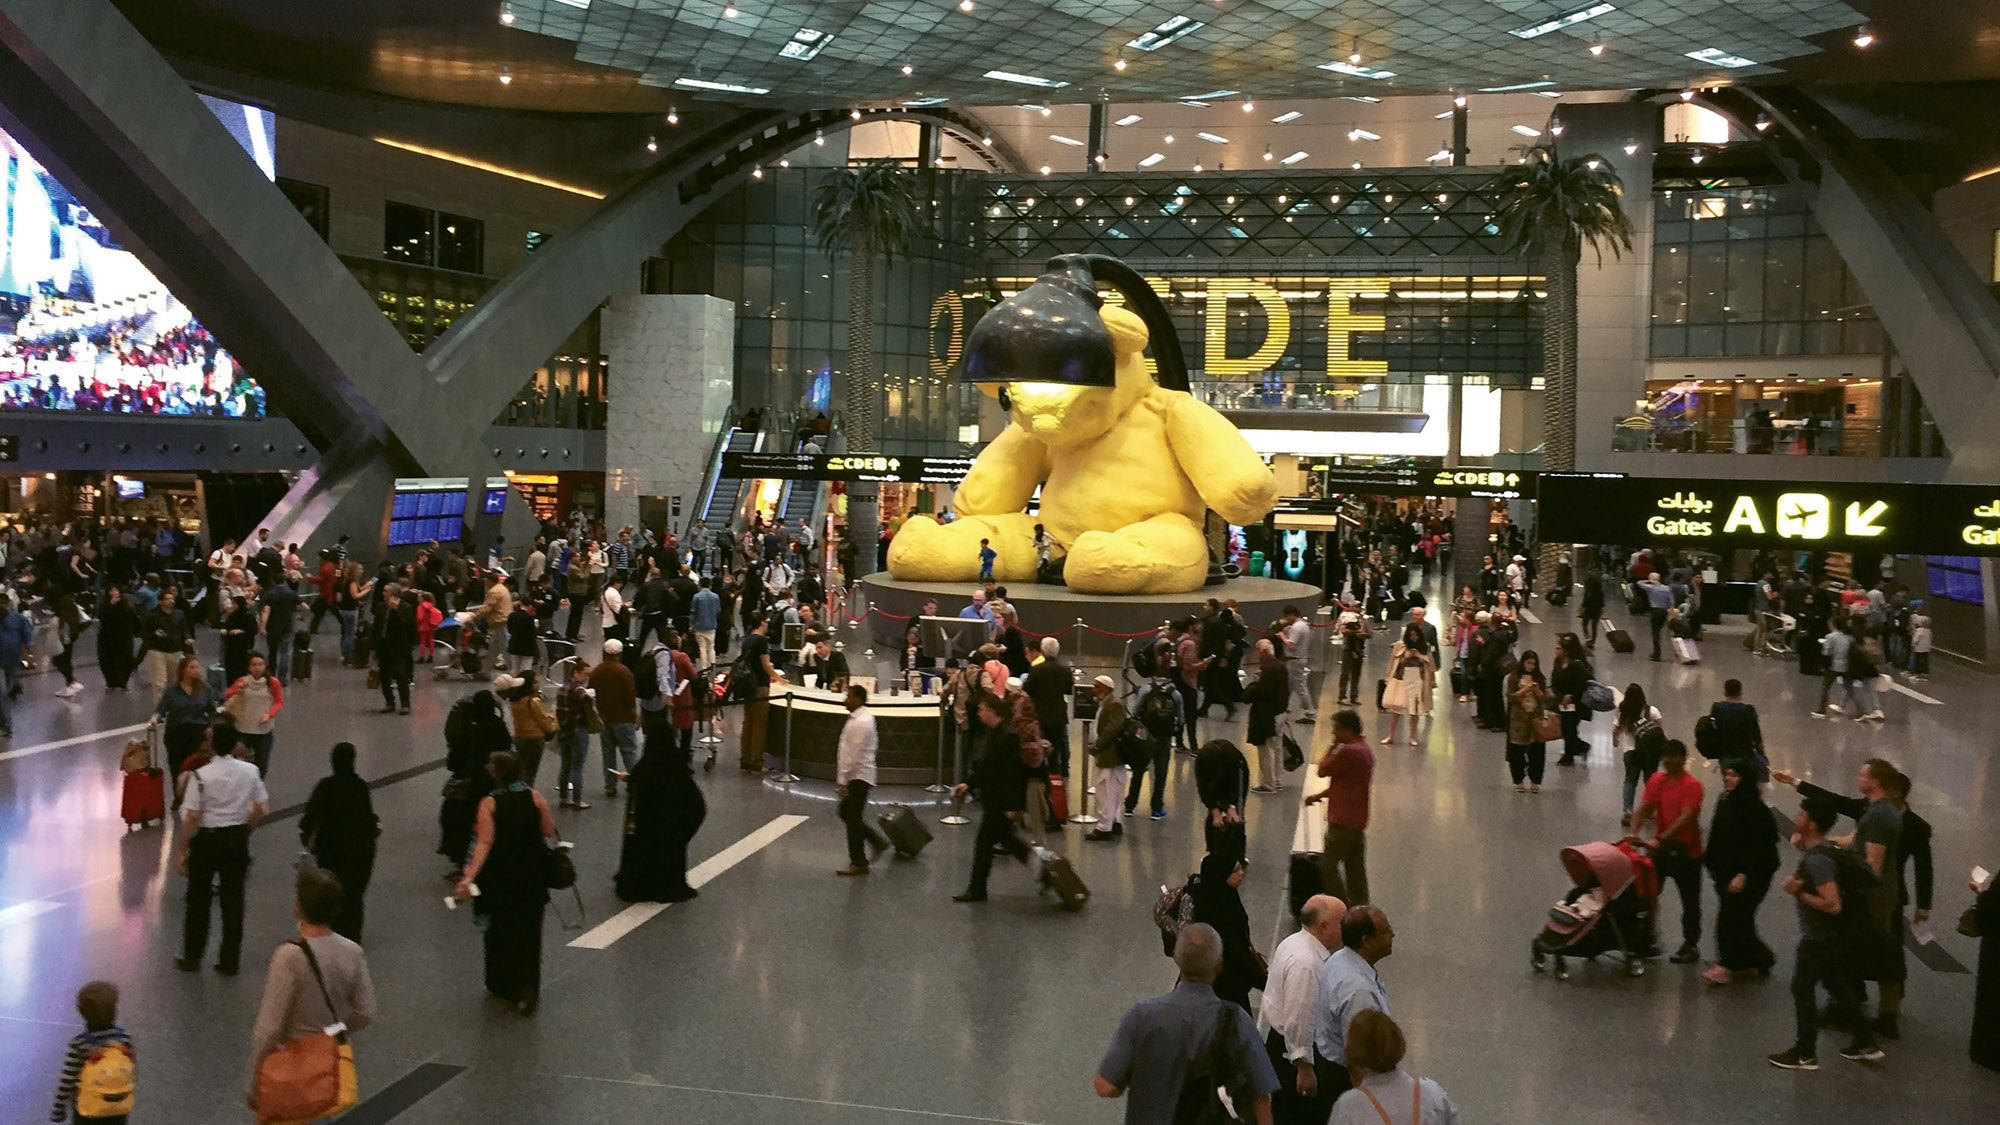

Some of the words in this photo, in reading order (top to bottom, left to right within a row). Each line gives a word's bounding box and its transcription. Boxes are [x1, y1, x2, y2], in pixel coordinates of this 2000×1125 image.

[1453, 472, 1488, 485] CDE
[1657, 491, 1713, 514] بوابات
[1722, 495, 1766, 534] A
[1646, 516, 1713, 536] Gates
